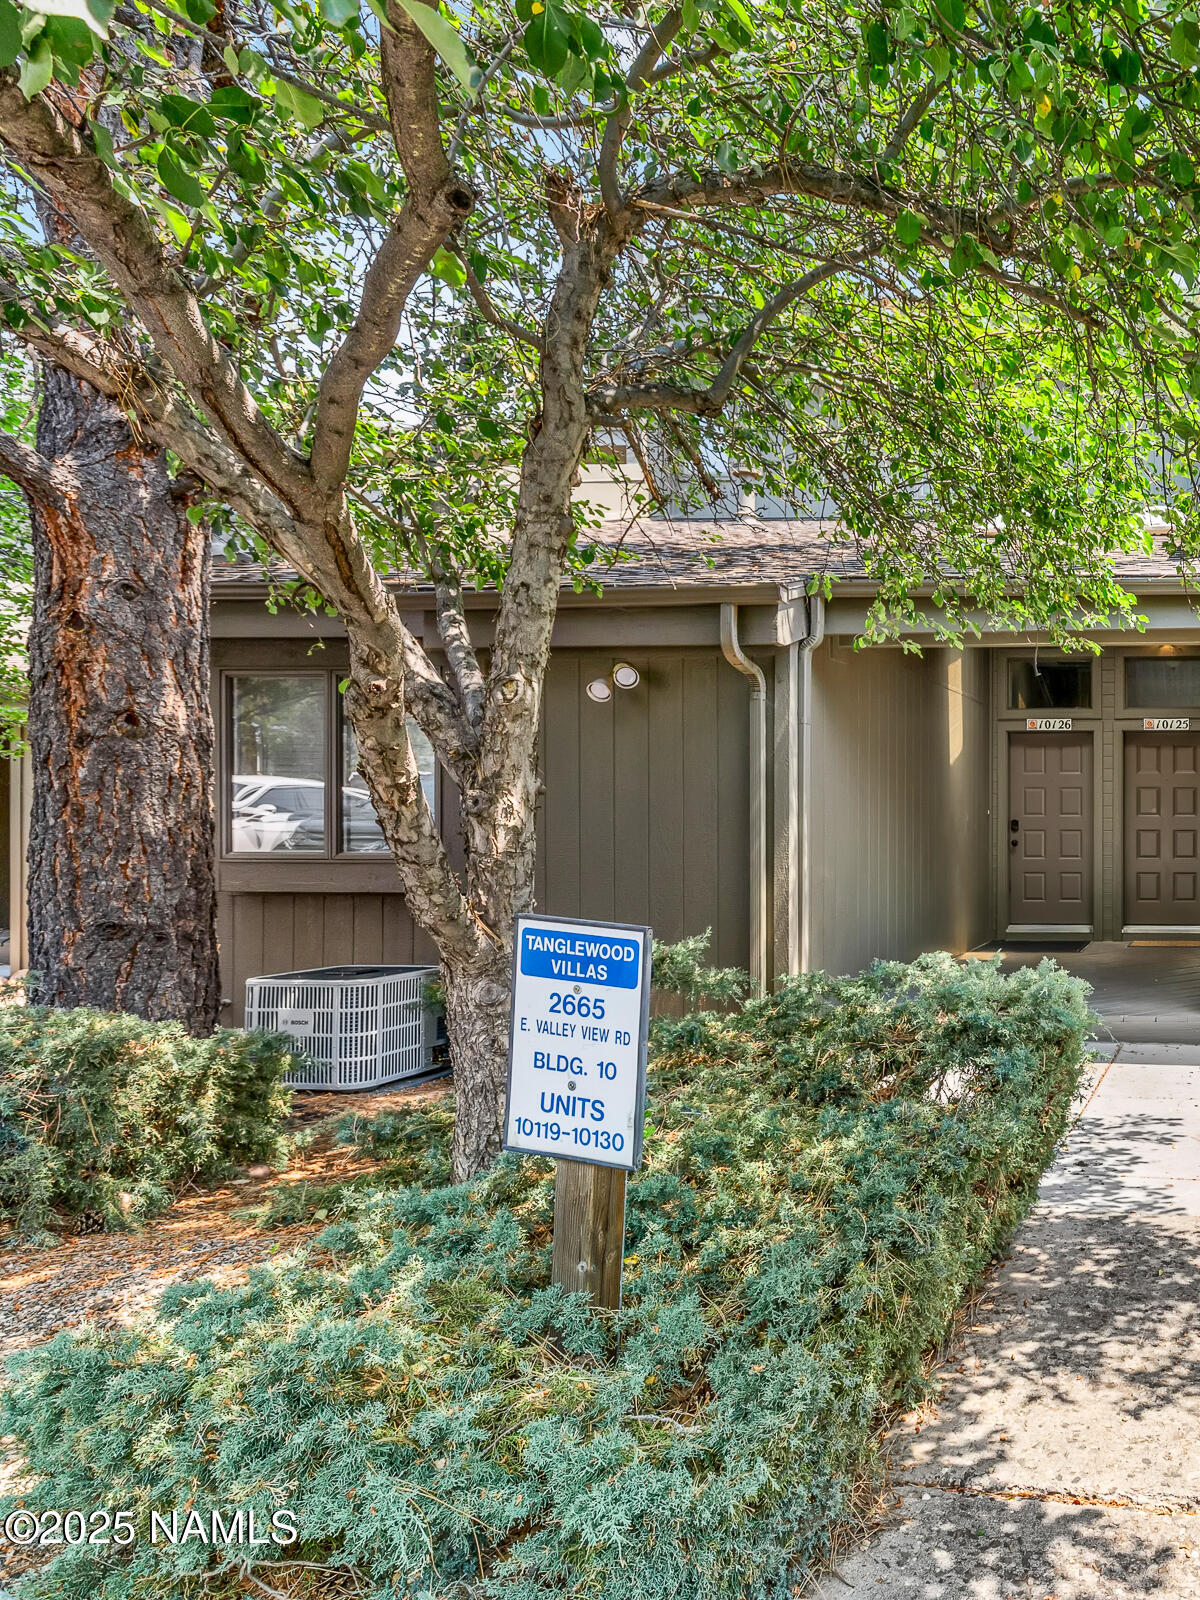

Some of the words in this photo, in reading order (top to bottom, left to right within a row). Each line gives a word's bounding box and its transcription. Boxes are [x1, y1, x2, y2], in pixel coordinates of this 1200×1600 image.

[1039, 720, 1070, 729] 10126
[1156, 720, 1188, 729] 10125
[525, 935, 635, 962] TANGLEWOOD
[551, 959, 608, 981] VILLAS
[549, 992, 605, 1020] 2665
[520, 1017, 531, 1032] E.
[536, 1019, 577, 1039] VALLEY
[581, 1025, 610, 1043] VIEW
[616, 1030, 631, 1046] RD
[533, 1051, 588, 1076] BLDG.
[597, 1061, 617, 1080] 10
[540, 1091, 605, 1122] UNITS
[514, 1116, 625, 1151] 10119-10130
